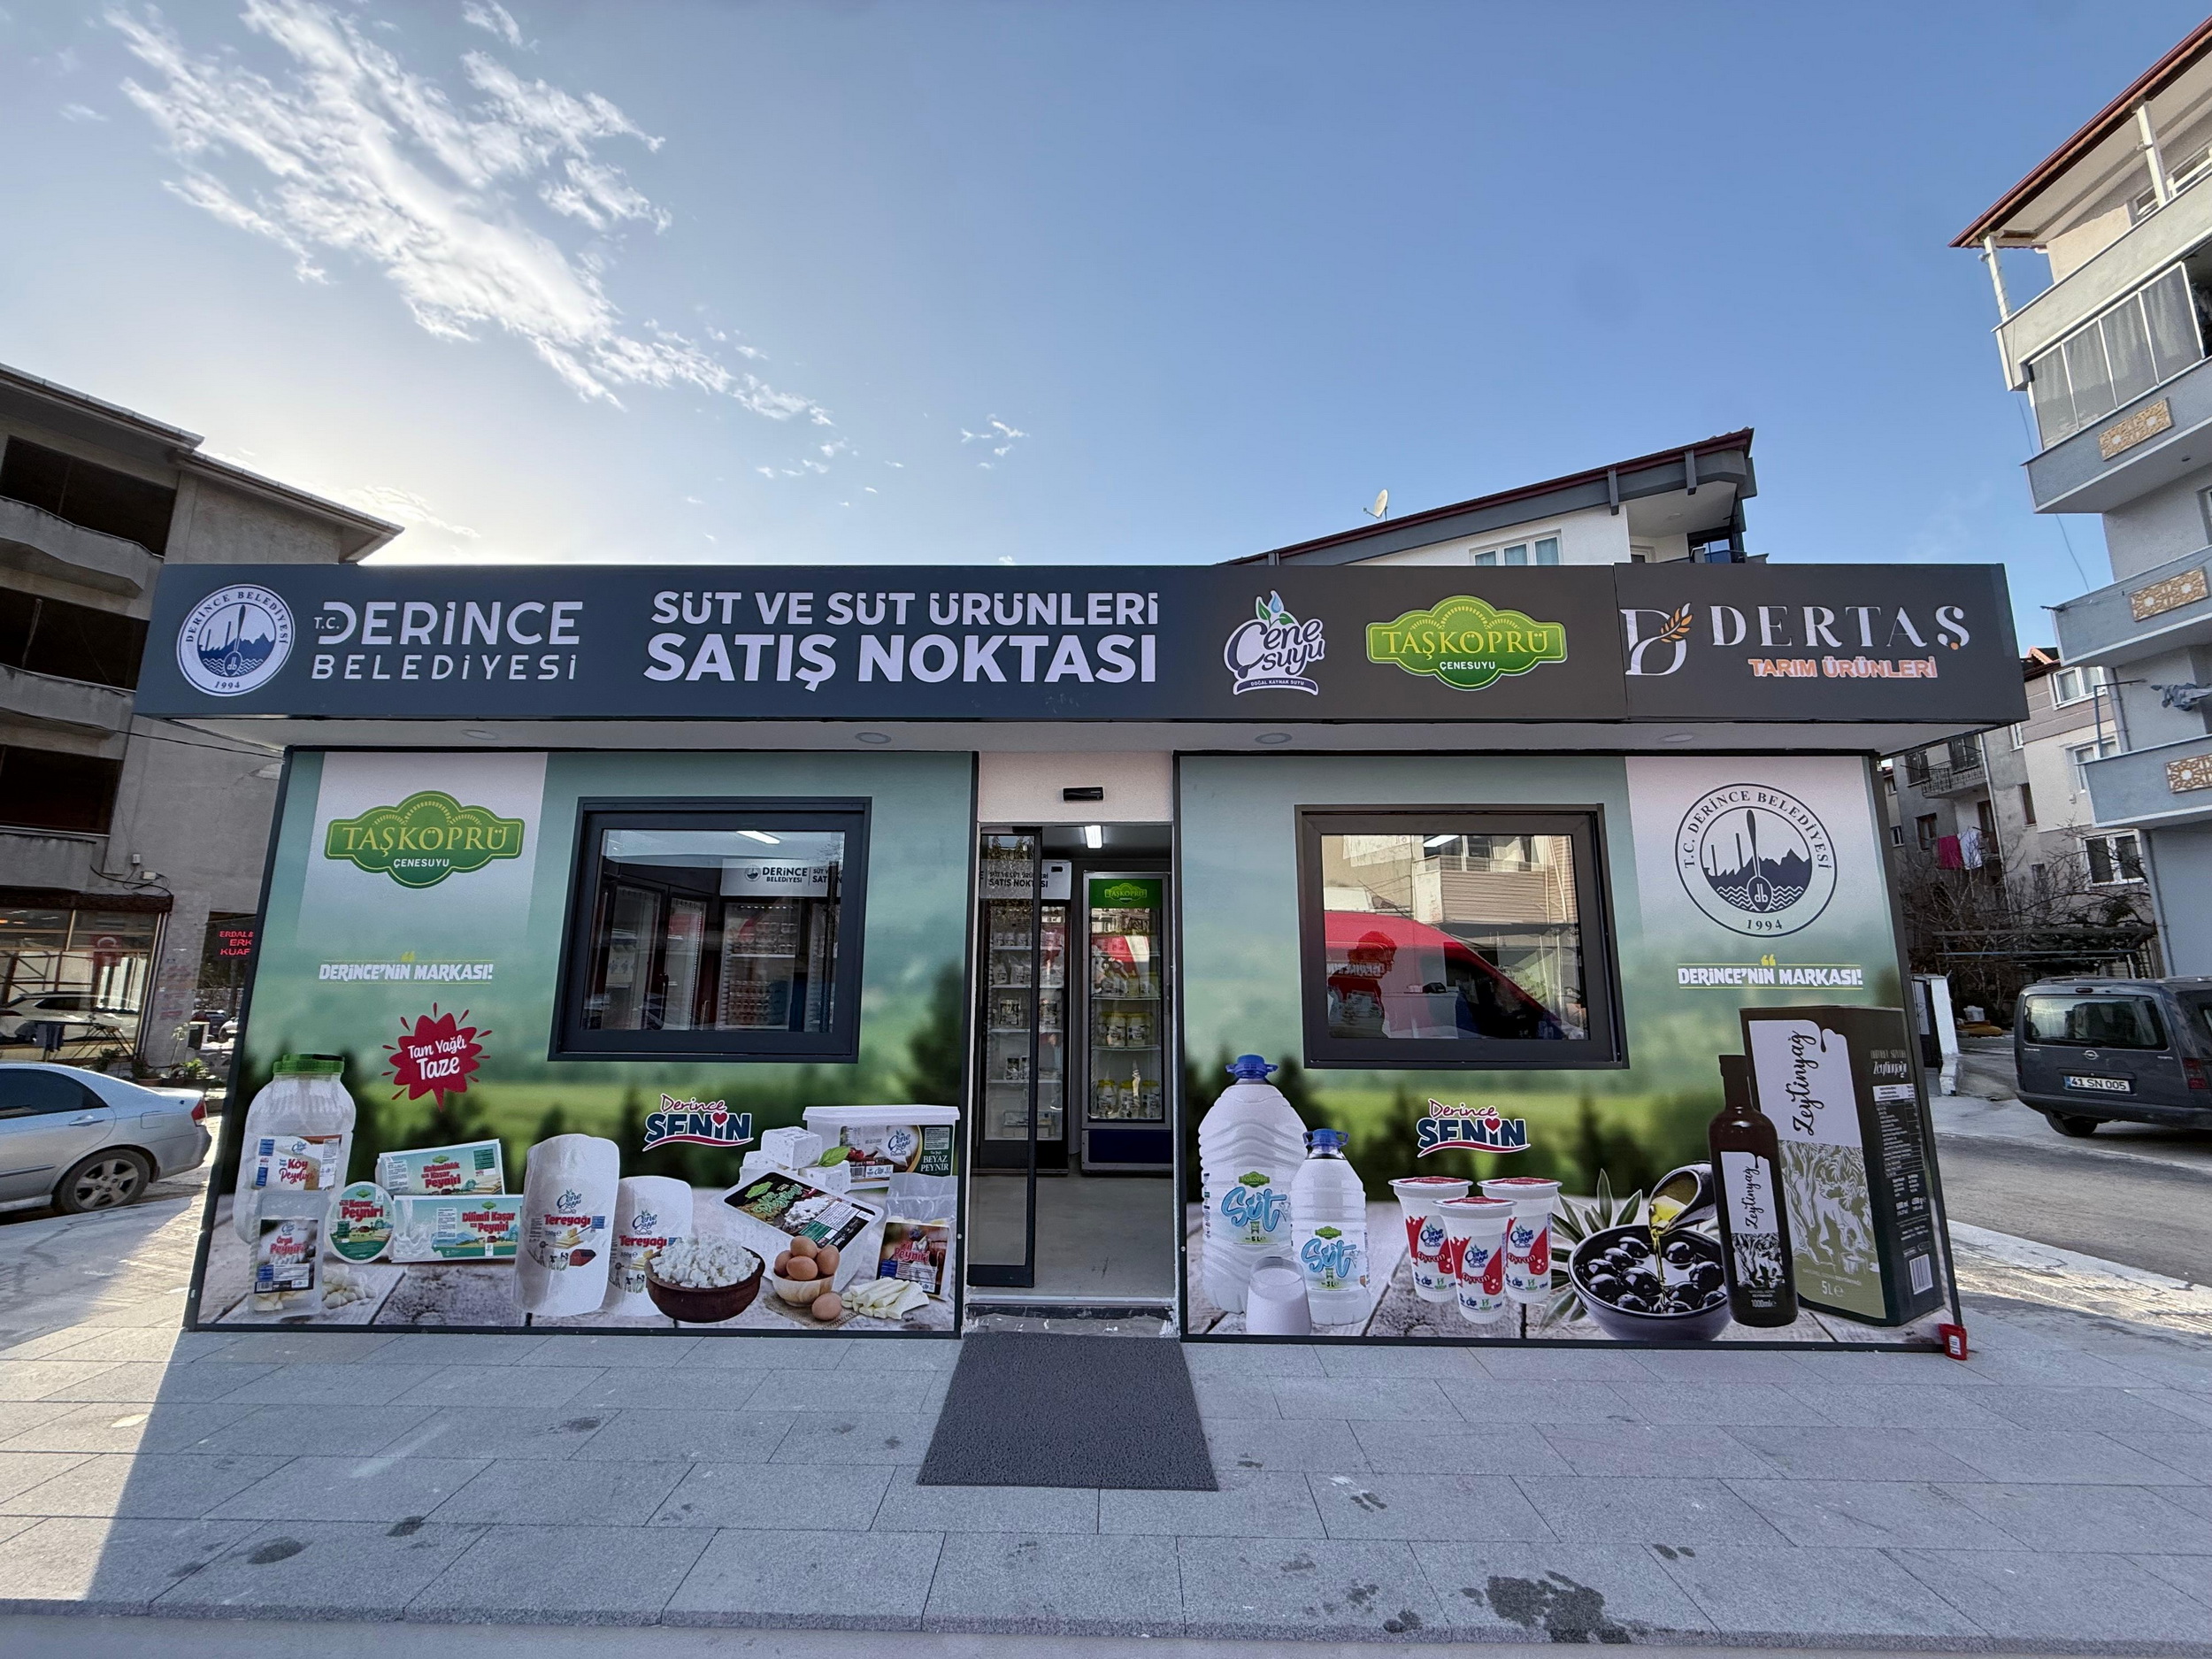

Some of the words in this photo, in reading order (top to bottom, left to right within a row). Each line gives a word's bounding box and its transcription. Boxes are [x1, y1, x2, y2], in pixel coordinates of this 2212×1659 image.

[651, 591, 741, 625] SÜT
[755, 592, 813, 625] VE
[826, 592, 915, 626] SÜT
[929, 592, 1158, 626] ÜRÜNLERİ
[314, 617, 340, 631] T.C.
[319, 601, 583, 645] DERİNCE
[1709, 605, 1970, 650] DERTAŞ
[1381, 630, 1548, 660] TAŞKÖPRÜ
[311, 654, 577, 680] BELEDİYESİ
[643, 632, 837, 693] SATIŞ
[857, 634, 1156, 683] NOKTASI
[1261, 640, 1324, 676] suyu
[1440, 660, 1496, 672] ÇENESUYU
[1748, 657, 1816, 678] TARIM
[1821, 655, 1938, 679] ÜRÜNLERİ
[214, 680, 241, 689] 1994
[1687, 790, 1751, 834] DERİNCE
[1757, 792, 1832, 870] BELEDİYESİ
[342, 826, 510, 857] TAŞKÖPRÜ
[393, 858, 450, 868] ÇENESUYU
[762, 866, 808, 877] DERİNCE
[1747, 918, 1783, 931] 1994
[413, 964, 494, 981] MARKASI!
[1778, 969, 1863, 986] MARKASI!
[407, 1045, 434, 1059] Tam
[434, 1034, 467, 1054] Yağlı
[416, 1056, 460, 1080] Taze
[2071, 1077, 2085, 1087] 41
[2087, 1078, 2103, 1088] SN
[2106, 1079, 2126, 1090] 005
[660, 1092, 727, 1113] Derince
[1428, 1098, 1498, 1118] Derince
[288, 1158, 308, 1170] Köy
[920, 1163, 949, 1172] PEYNİR
[923, 1155, 948, 1164] BEYAZ
[341, 1205, 383, 1222] Peyniri
[1221, 1187, 1287, 1233] Süt
[544, 1214, 591, 1228] Tereyağı
[619, 1234, 667, 1249] Tereyağı
[1301, 1238, 1356, 1279] Süt
